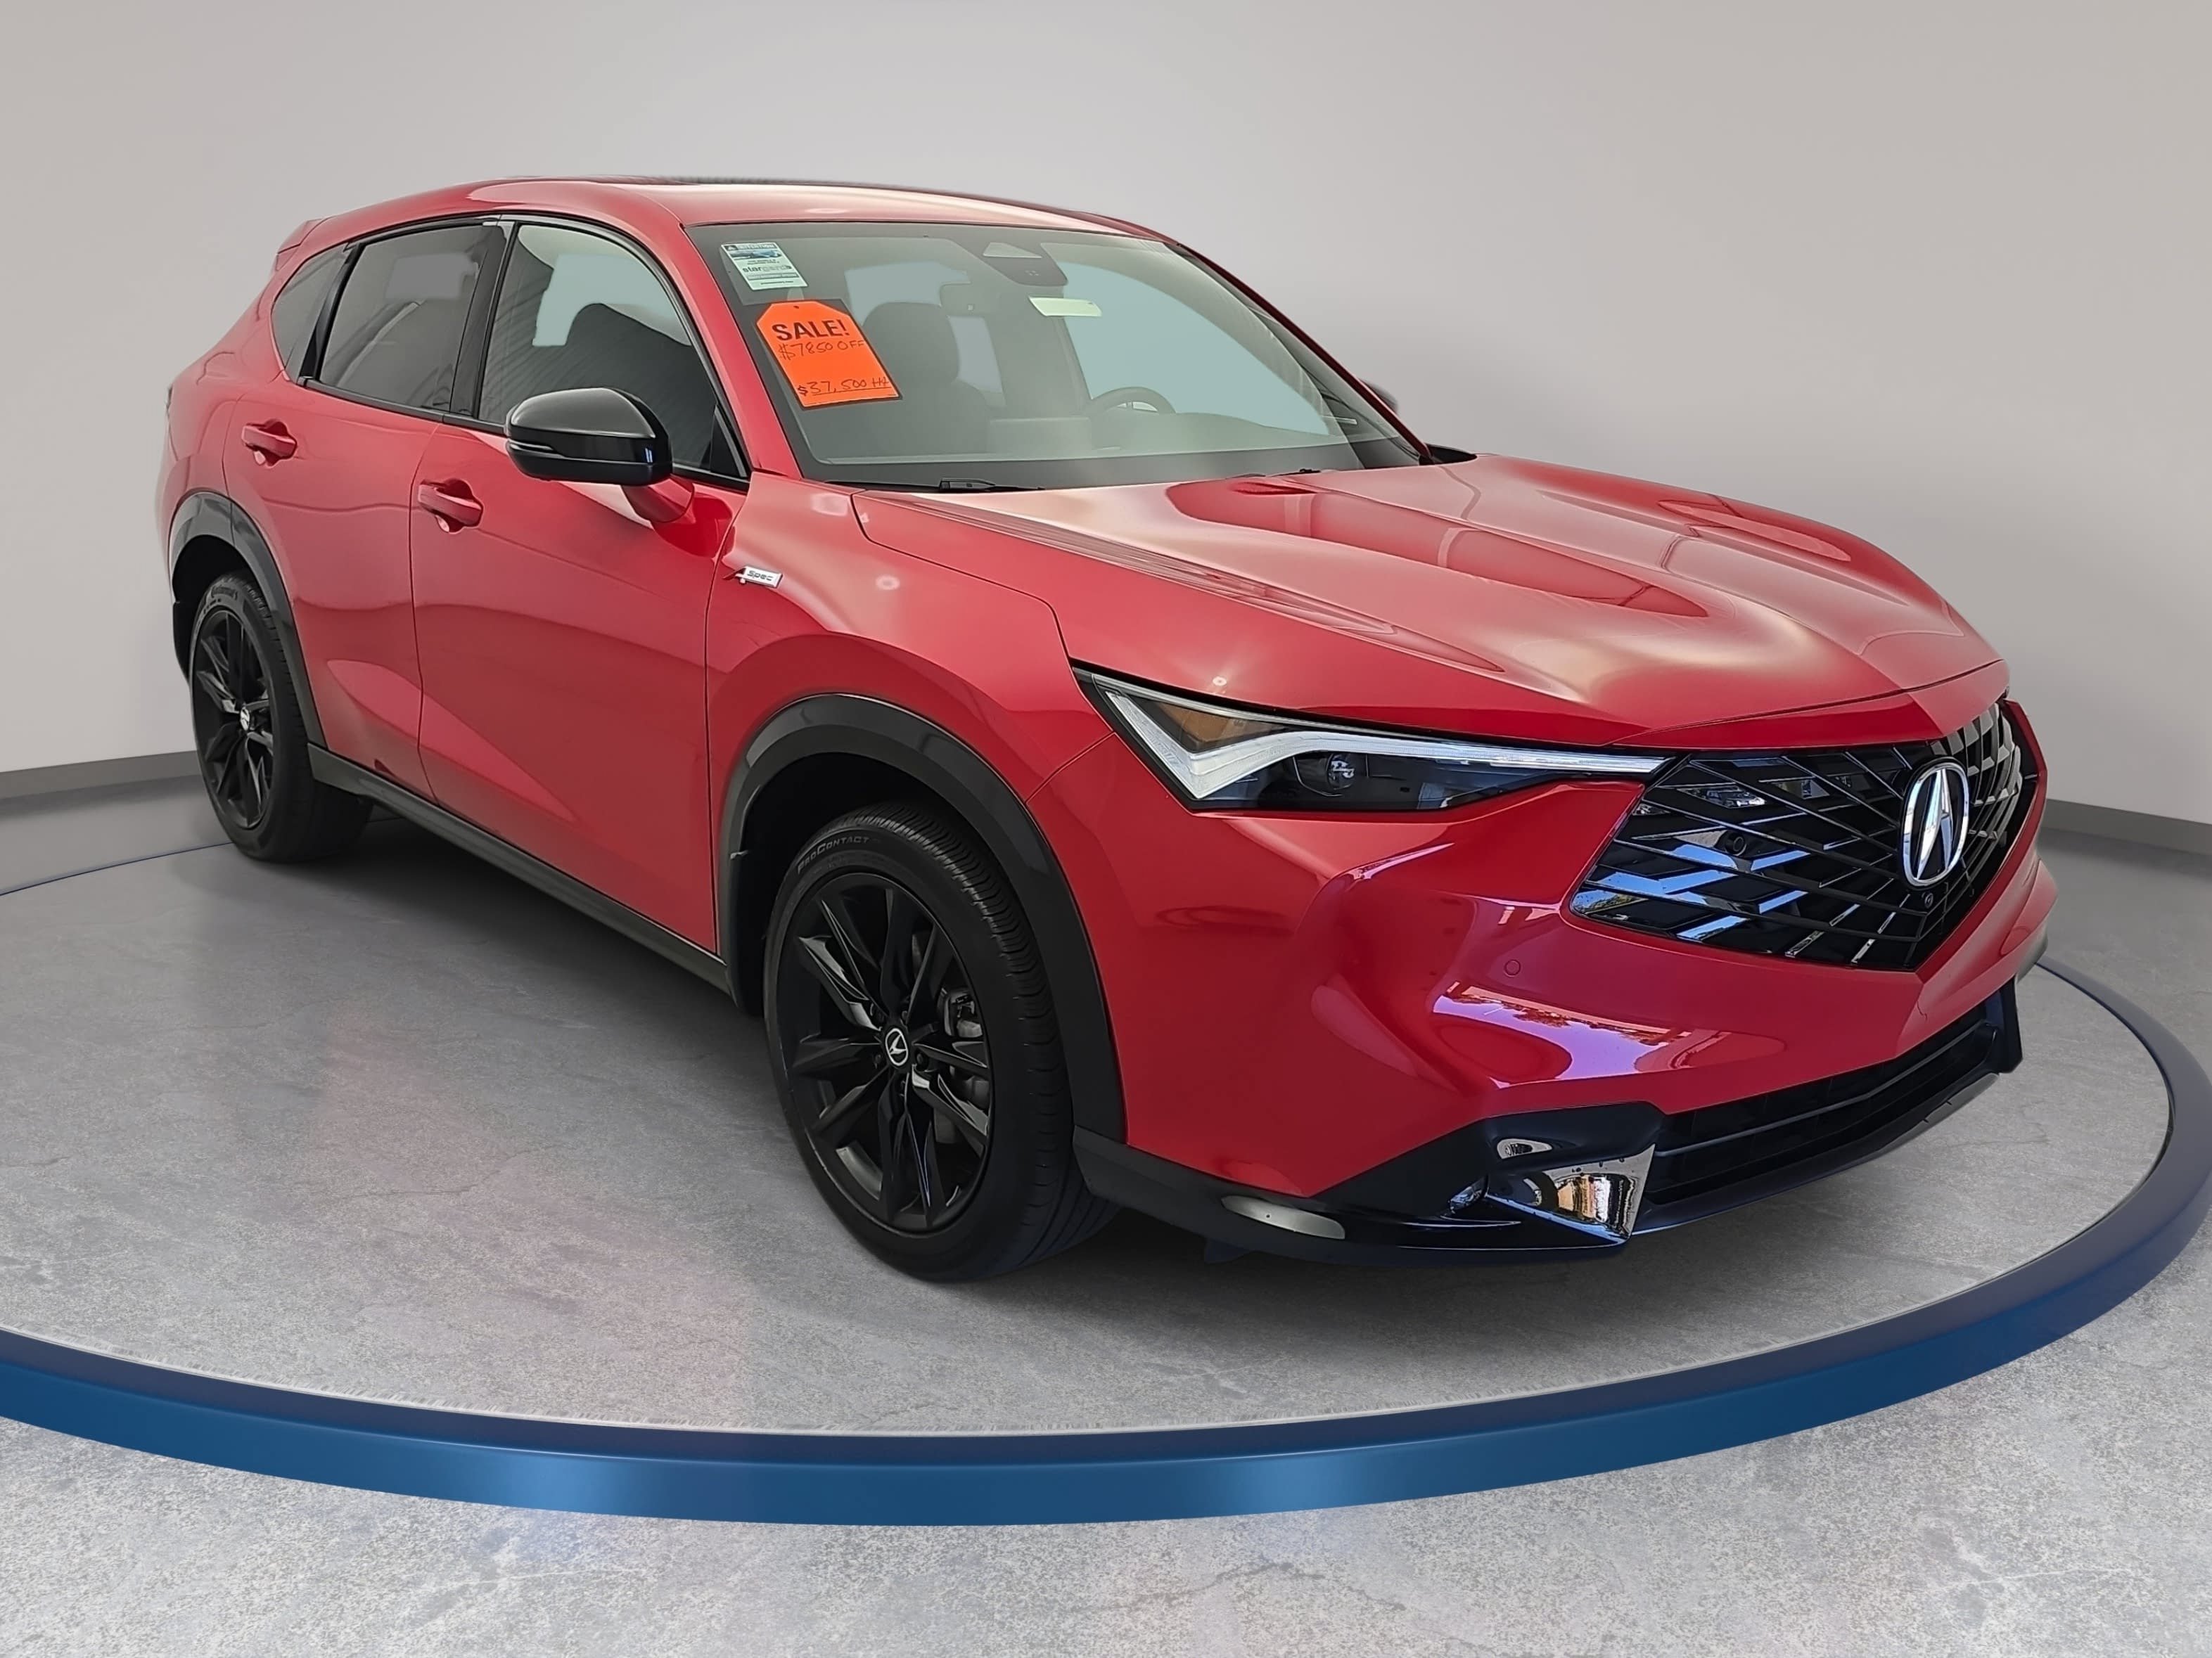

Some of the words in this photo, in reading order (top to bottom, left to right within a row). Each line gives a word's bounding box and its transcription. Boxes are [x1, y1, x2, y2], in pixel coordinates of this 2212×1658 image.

[772, 319, 850, 340] SALE!
[778, 341, 833, 360] $7850
[837, 340, 864, 351] OFF
